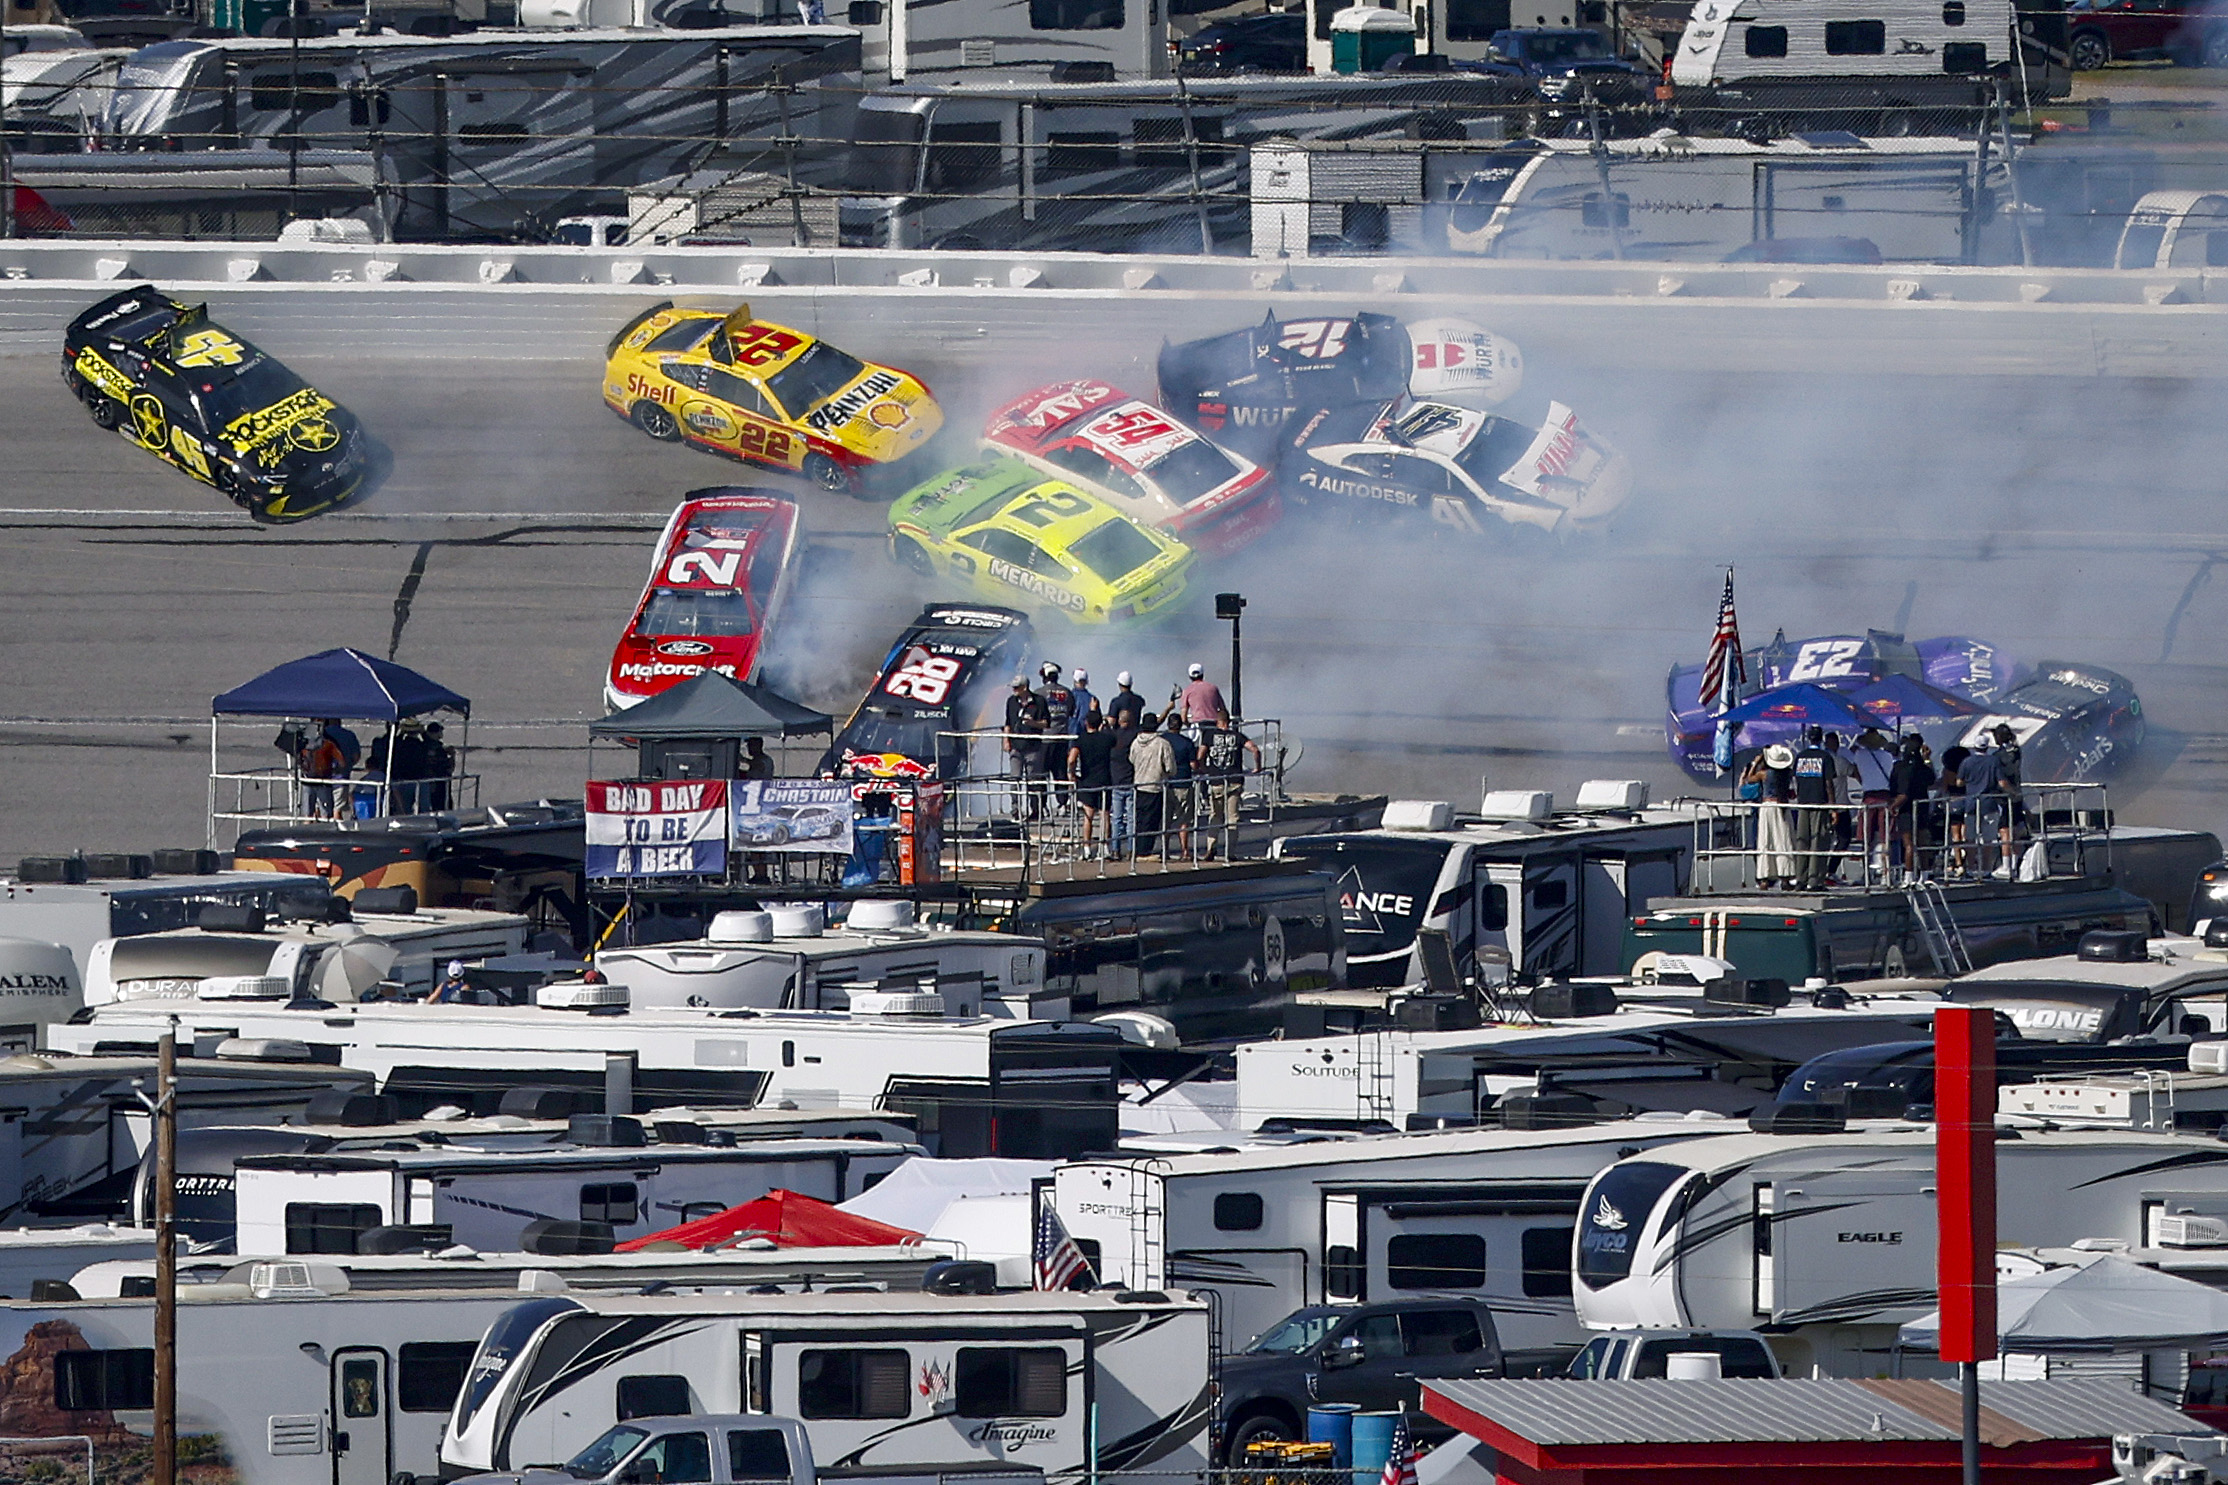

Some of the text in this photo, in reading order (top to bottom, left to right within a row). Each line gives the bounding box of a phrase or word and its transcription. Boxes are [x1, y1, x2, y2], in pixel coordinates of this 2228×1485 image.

[627, 372, 676, 405] Shell
[808, 371, 902, 436] PENNZOIL
[740, 422, 791, 461] 22
[1318, 476, 1419, 506] AUTODESK
[1007, 491, 1093, 529] 2
[990, 556, 1086, 612] MENARDS
[619, 662, 737, 680] Motorcrft
[1789, 640, 1864, 681] 23
[605, 783, 704, 812] BAD DAY
[739, 780, 764, 815] 1
[762, 786, 848, 804] CHASTAIN
[623, 817, 688, 842] TO BE
[615, 846, 694, 873] A BEER
[1291, 1063, 1360, 1077] SOLITUDE
[1837, 1231, 1903, 1243] EAGLE
[969, 1420, 1056, 1453] Imagine
